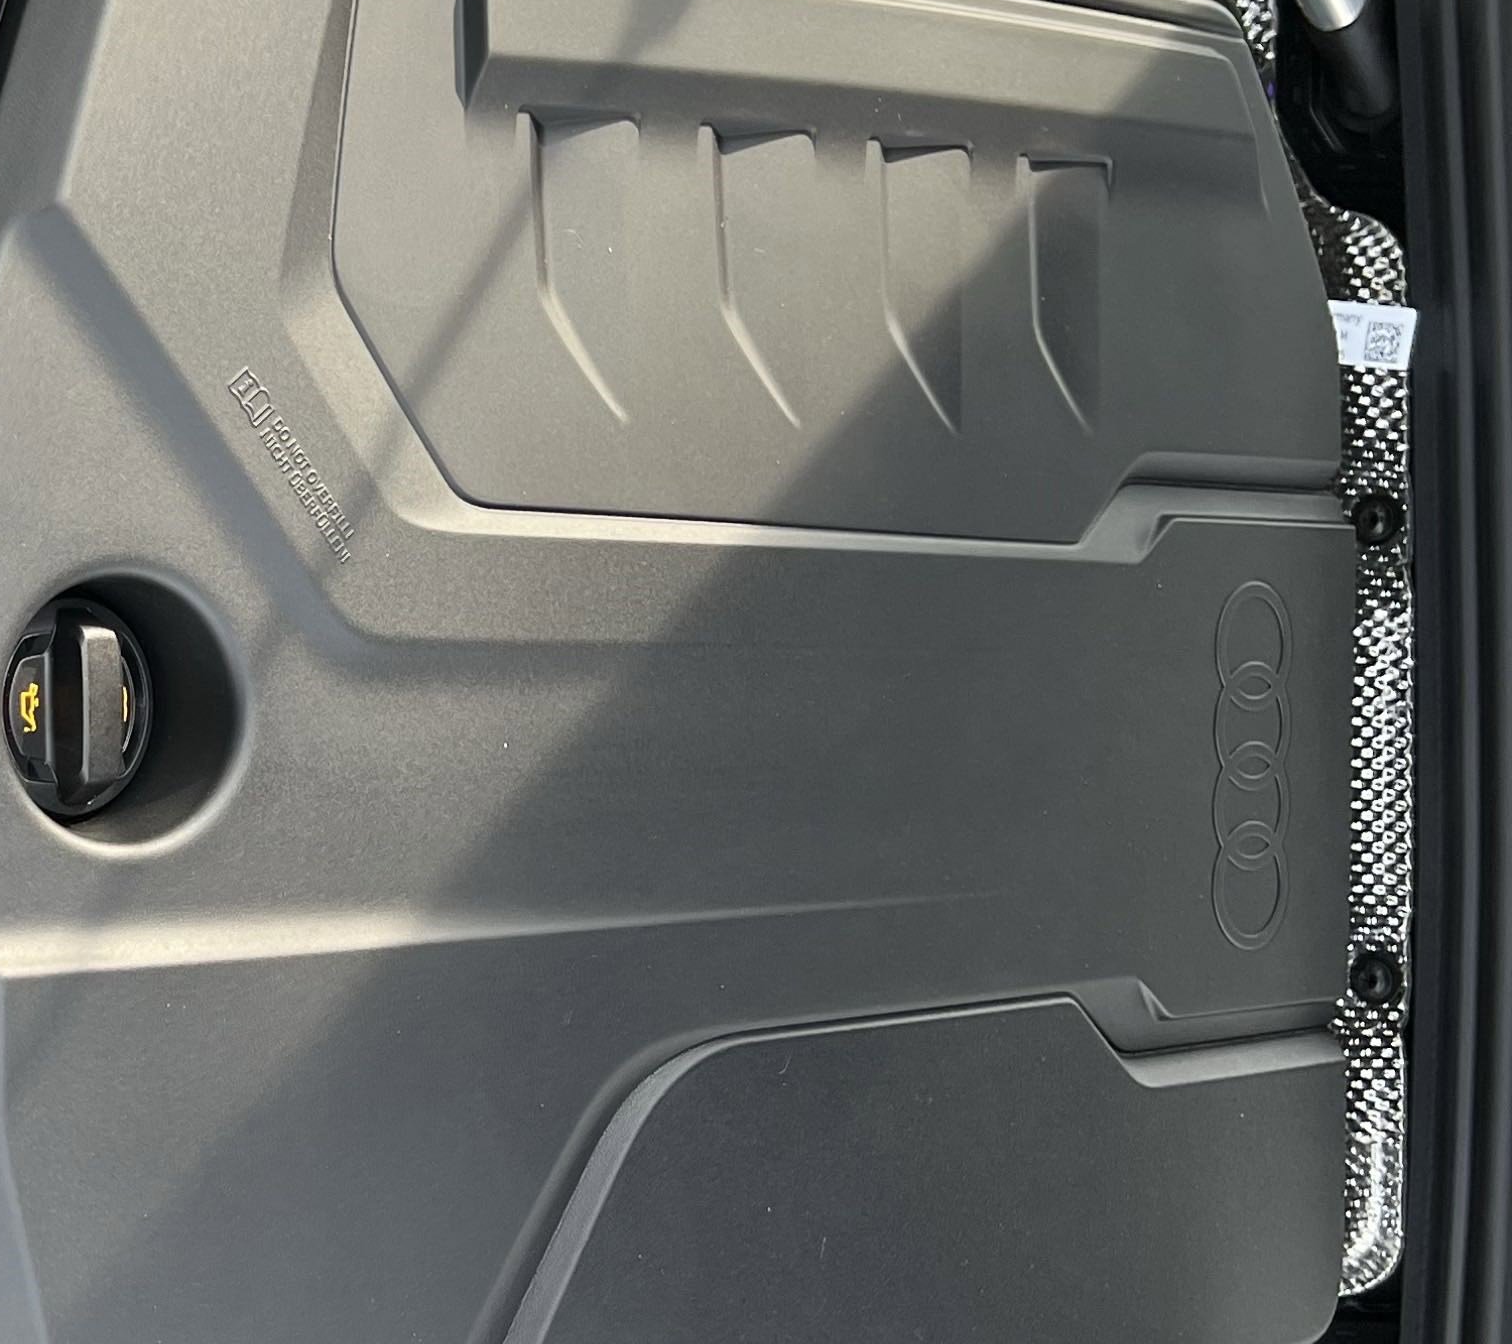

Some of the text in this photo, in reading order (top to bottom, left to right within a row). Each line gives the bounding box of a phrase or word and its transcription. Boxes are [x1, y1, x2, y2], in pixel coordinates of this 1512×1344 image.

[259, 427, 295, 474] NICHT
[270, 417, 291, 443] DO
[284, 439, 312, 471] NOT
